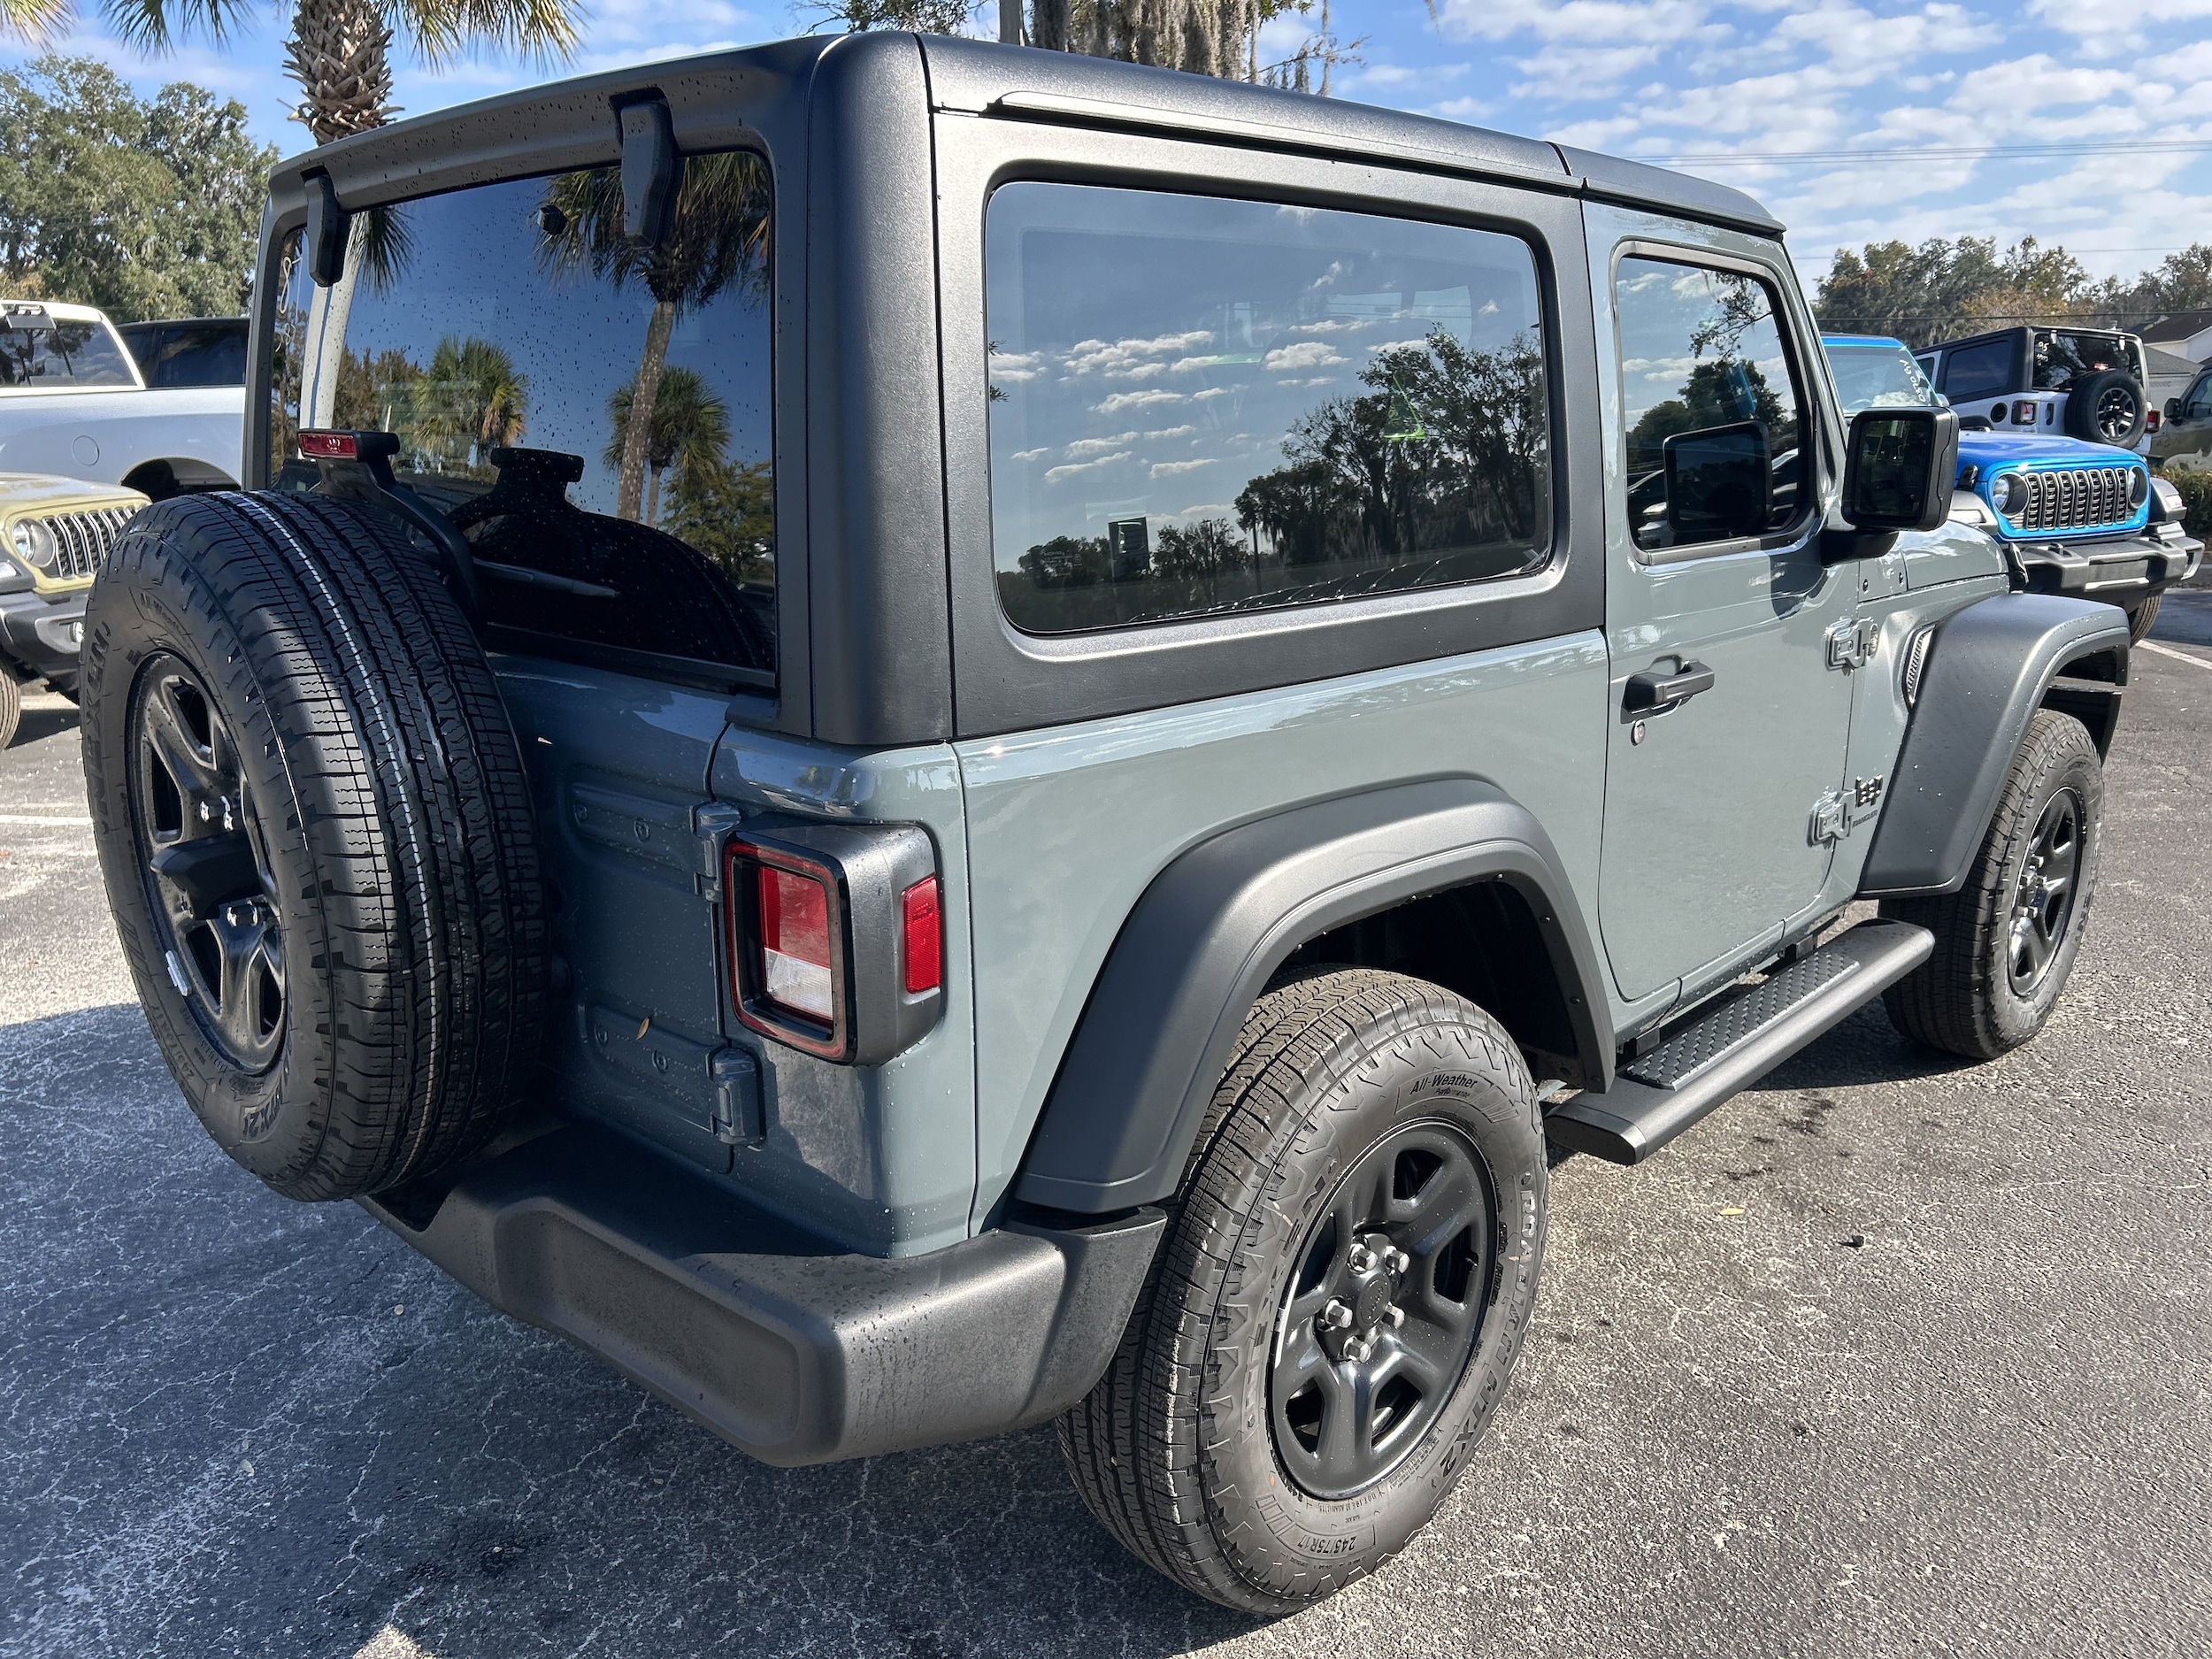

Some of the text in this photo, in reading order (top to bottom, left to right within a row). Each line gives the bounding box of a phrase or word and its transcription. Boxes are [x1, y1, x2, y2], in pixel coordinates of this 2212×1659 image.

[87, 628, 109, 816] NEXEN
[1409, 1073, 1478, 1095] All-Weather
[1297, 1534, 1357, 1554] 245/75R17
